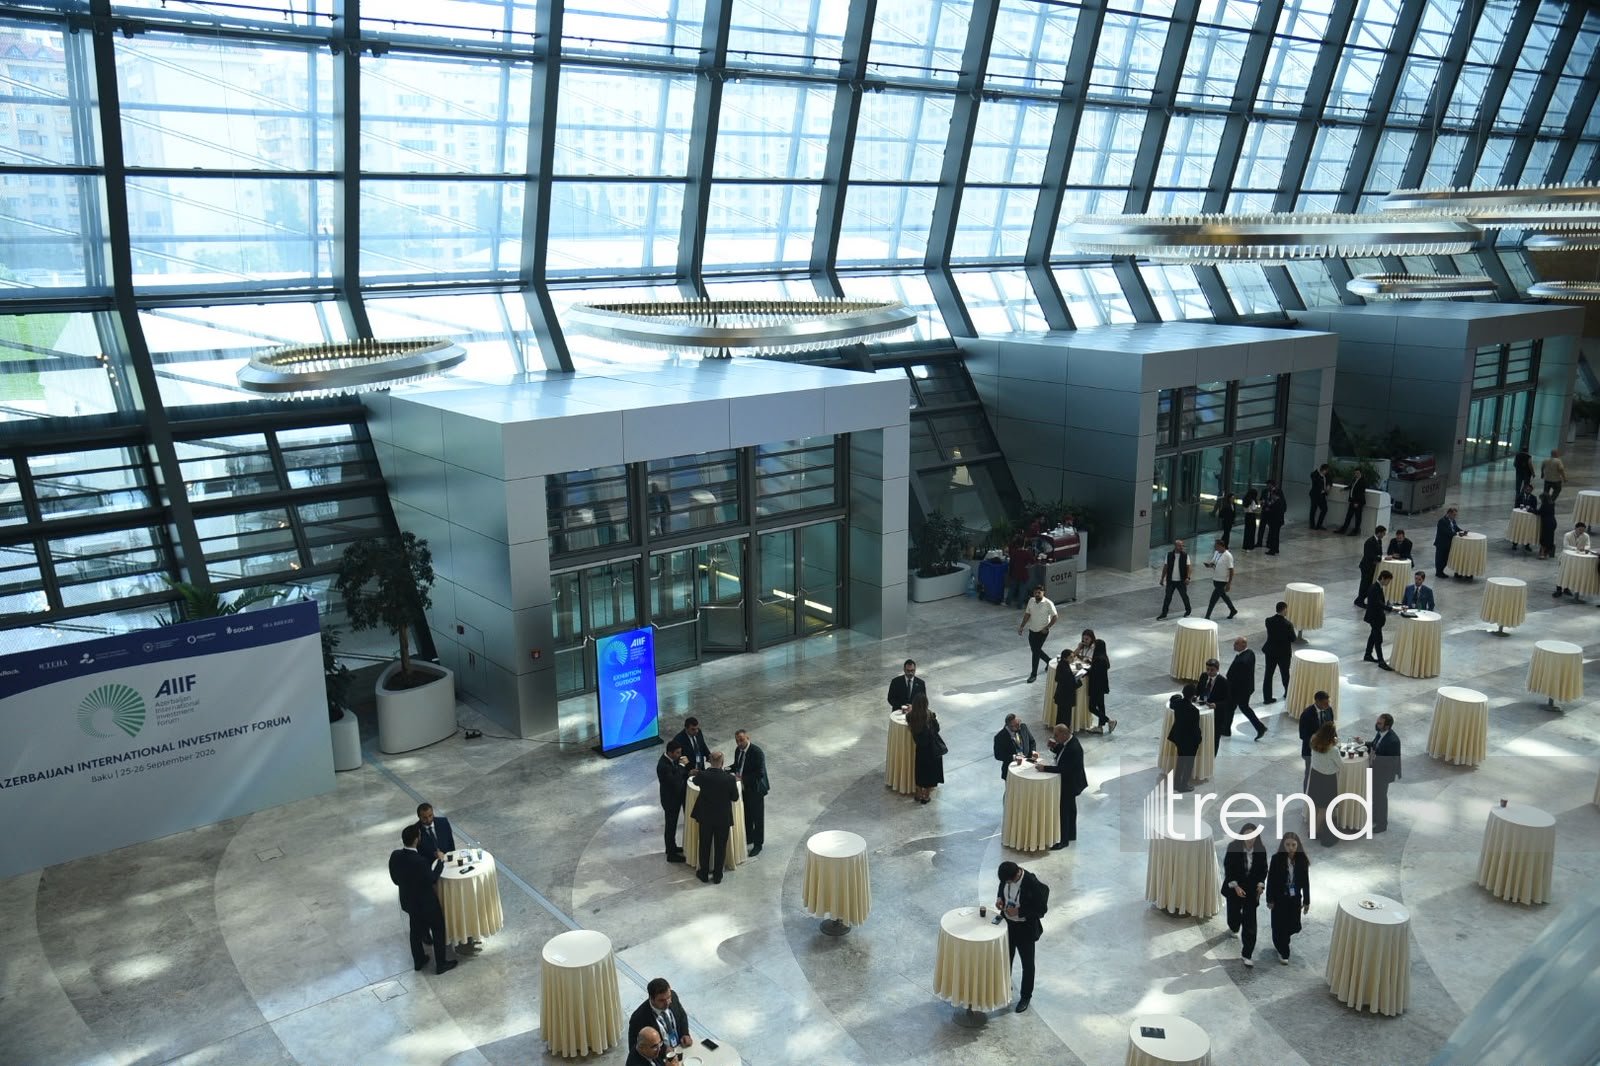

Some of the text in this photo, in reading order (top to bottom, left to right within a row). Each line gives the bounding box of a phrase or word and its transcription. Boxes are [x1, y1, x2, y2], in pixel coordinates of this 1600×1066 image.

[1050, 571, 1072, 582] COSTA
[233, 625, 254, 634] SOCAR
[630, 637, 646, 648] AIIF
[155, 674, 197, 698] AIIF
[77, 742, 175, 772] INTERNATIONAL
[178, 724, 249, 749] INVESTMENT
[251, 715, 291, 732] FORUM
[91, 772, 114, 783] Baku
[121, 764, 144, 777] 25-26
[146, 753, 194, 770] September
